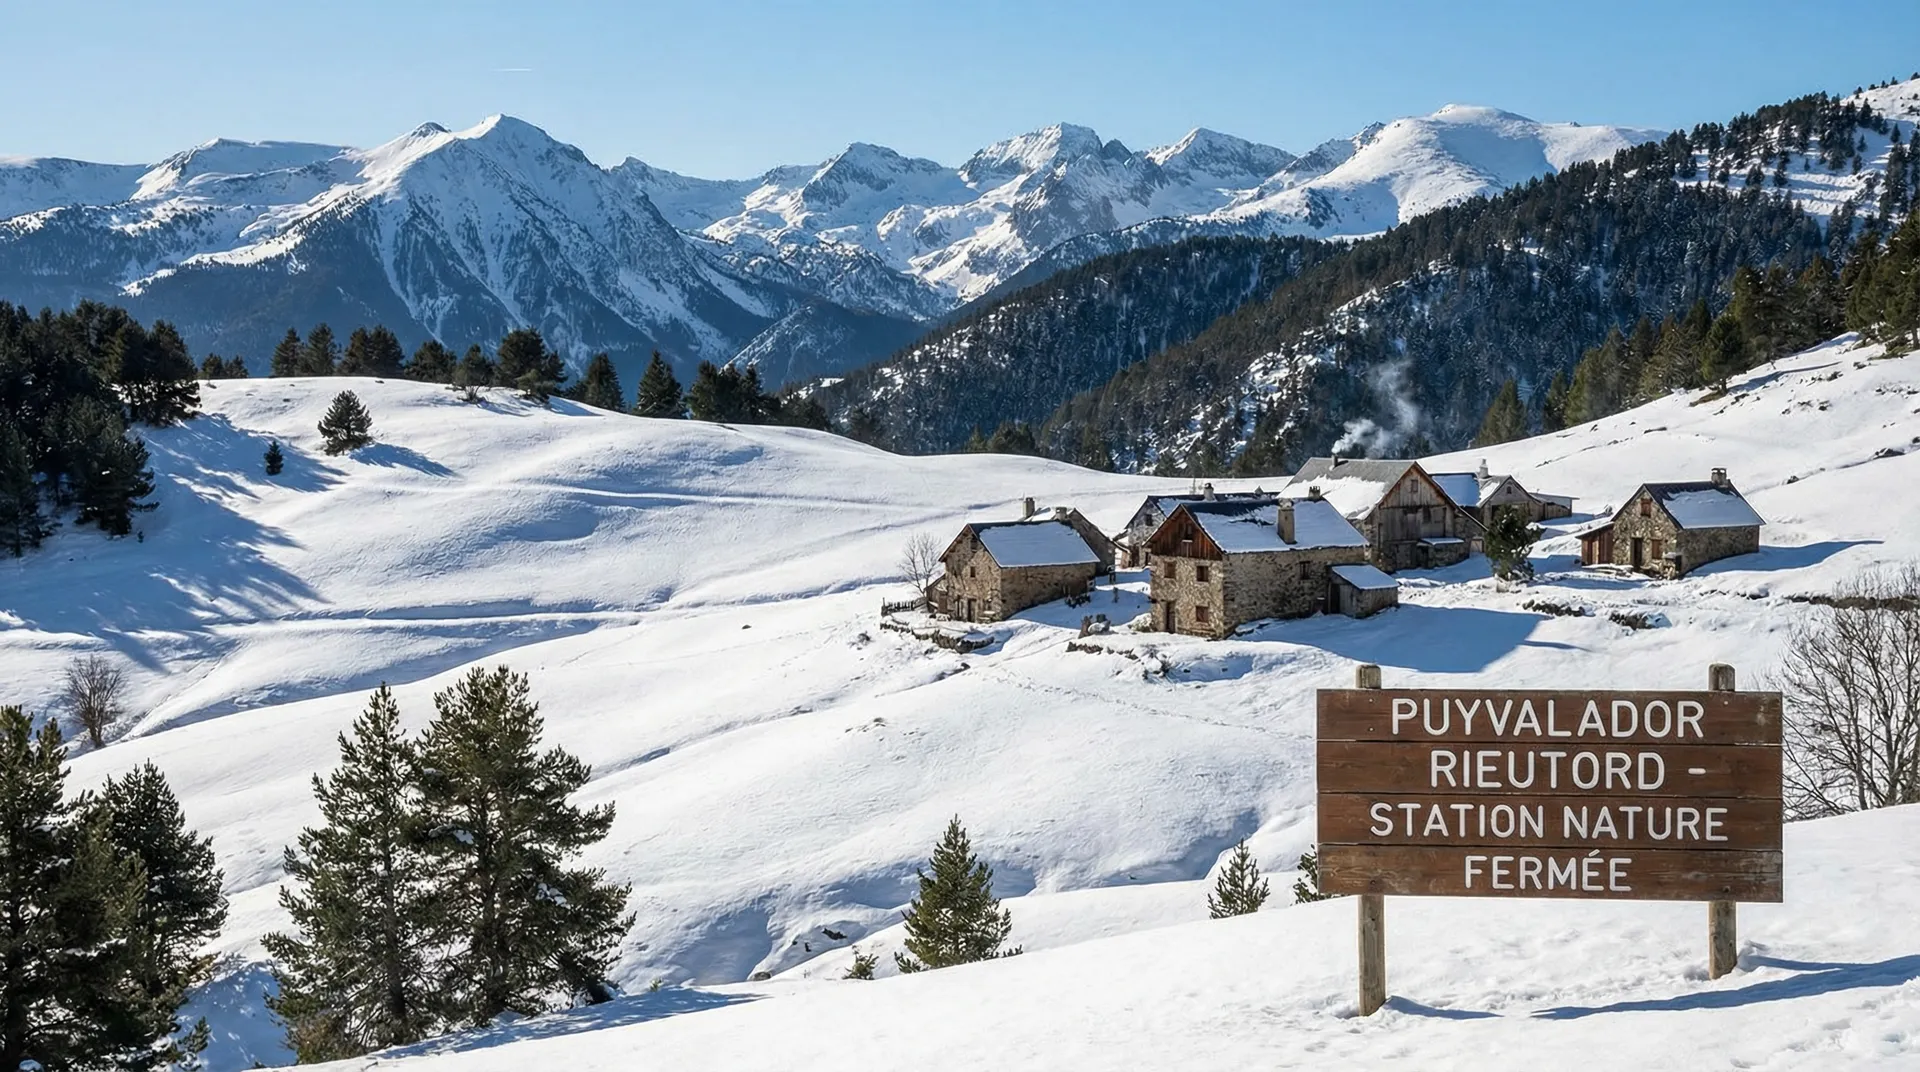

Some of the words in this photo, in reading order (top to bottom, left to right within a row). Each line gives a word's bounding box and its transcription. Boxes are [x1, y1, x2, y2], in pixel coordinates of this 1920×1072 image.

[1391, 698, 1705, 738] PUYVALADOR
[1430, 750, 1666, 790] RIEUTORD
[1370, 802, 1544, 839] STATION
[1563, 805, 1729, 841] NATURE
[1465, 849, 1633, 891] FERMÉE
